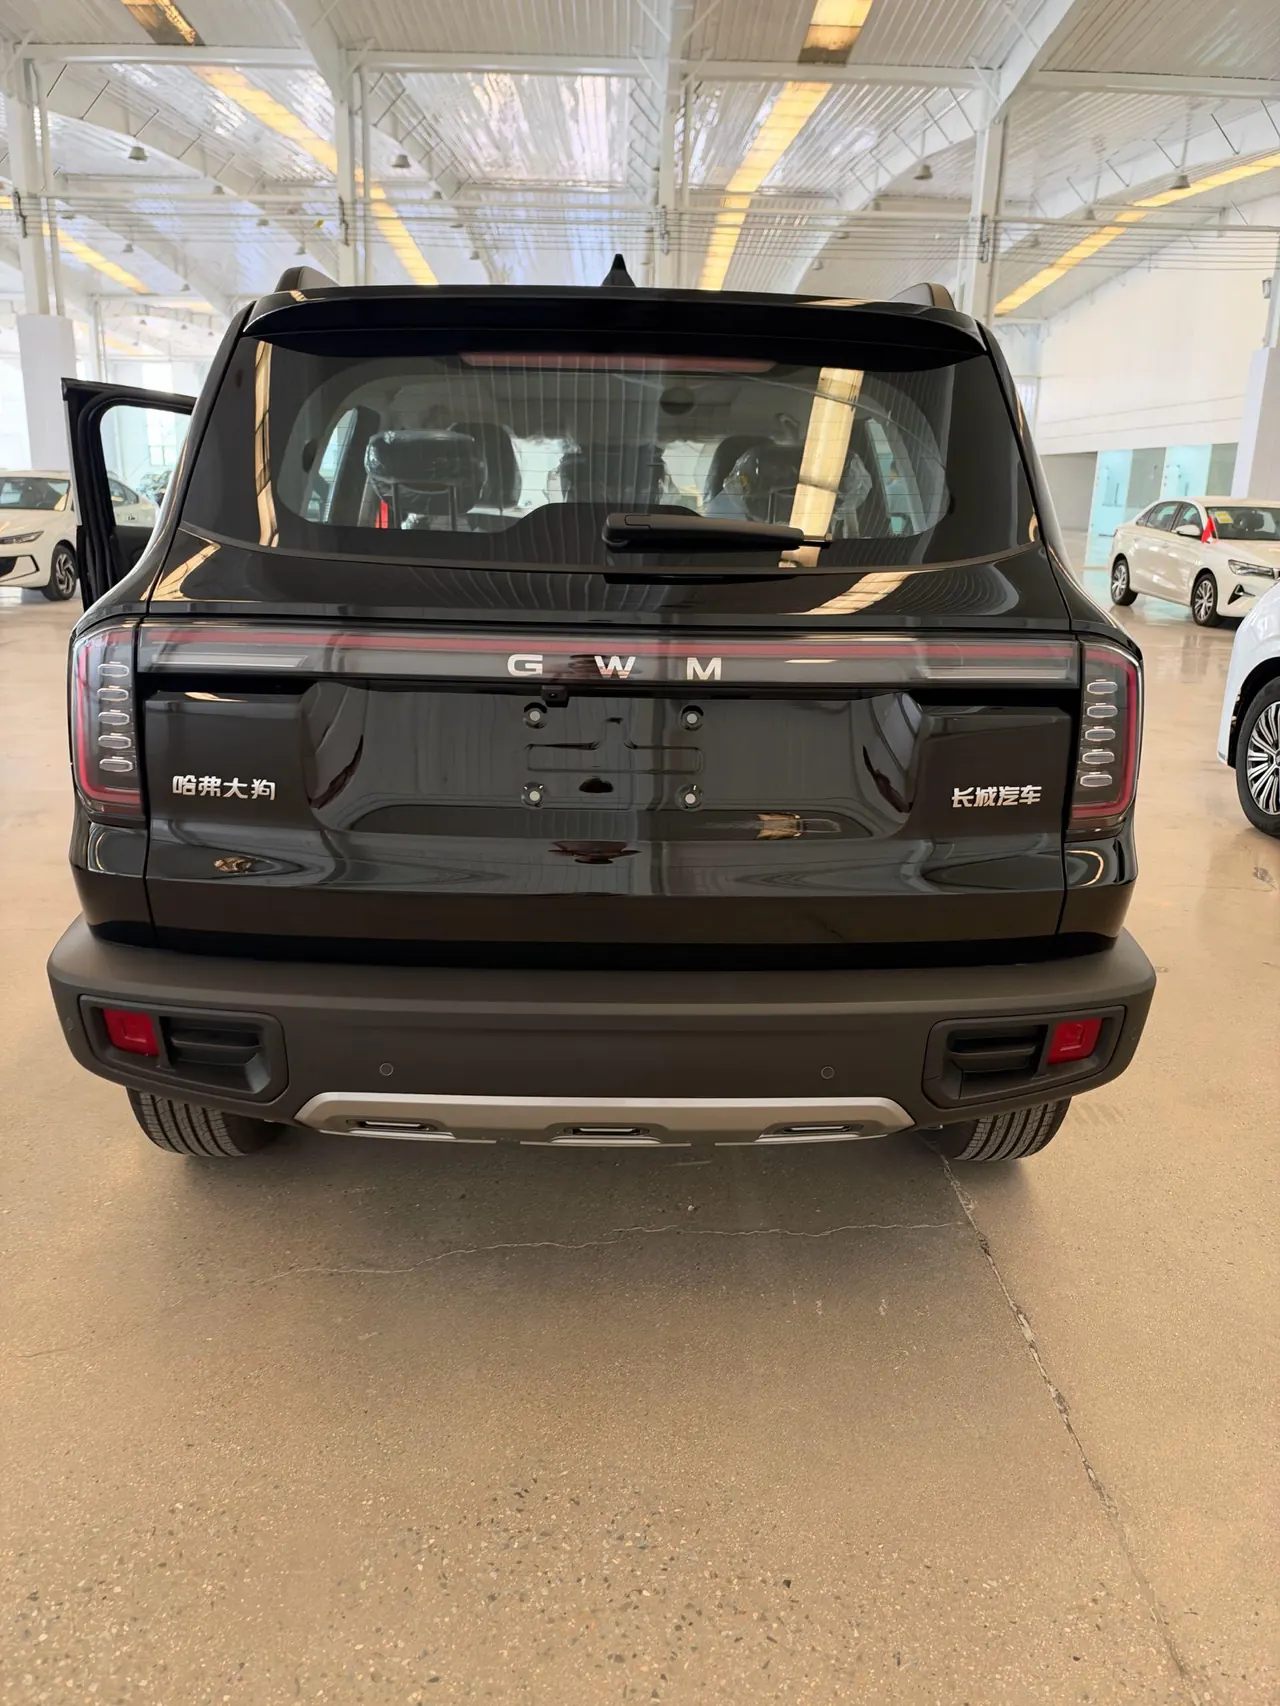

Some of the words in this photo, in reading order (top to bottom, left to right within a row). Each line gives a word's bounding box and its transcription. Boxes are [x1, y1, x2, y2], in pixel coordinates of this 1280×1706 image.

[507, 653, 722, 681] GWM
[172, 774, 276, 801] 哈弗大狗
[951, 784, 1042, 808] 长城汽车
